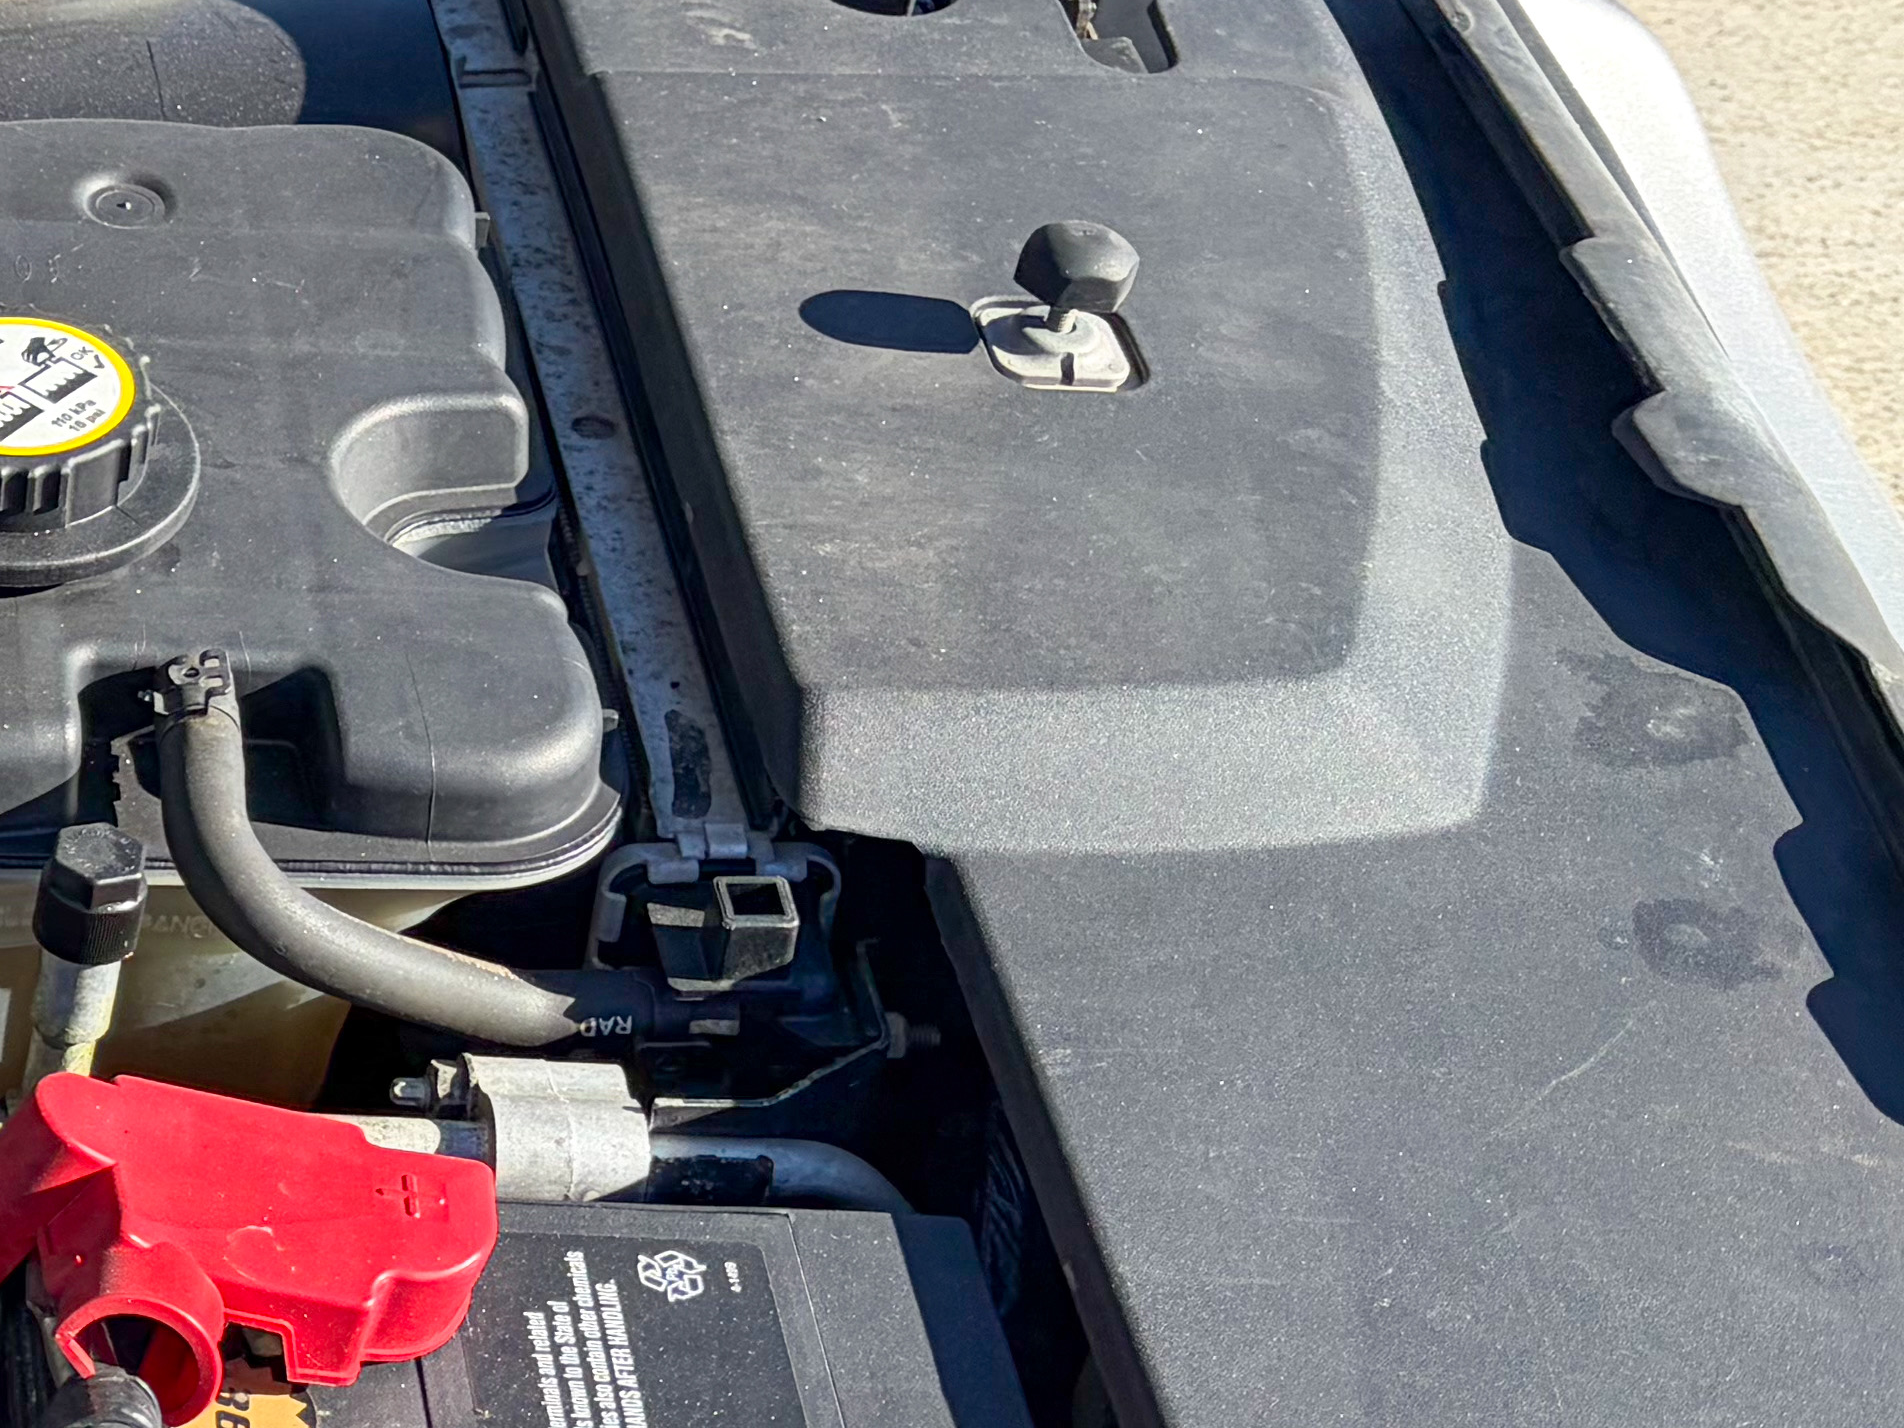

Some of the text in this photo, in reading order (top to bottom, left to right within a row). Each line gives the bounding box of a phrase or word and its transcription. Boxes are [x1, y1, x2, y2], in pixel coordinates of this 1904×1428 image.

[70, 346, 94, 361] OK
[69, 399, 97, 416] kPa
[580, 1015, 632, 1037] RAD
[563, 1250, 594, 1307] chemicals
[546, 1300, 569, 1312] of
[595, 1278, 629, 1345] HANDLING.
[523, 1311, 551, 1351] related
[552, 1313, 576, 1344] State
[577, 1308, 601, 1338] other
[531, 1352, 556, 1375] and
[558, 1345, 580, 1364] the
[583, 1339, 610, 1382] contain
[610, 1347, 638, 1387] AFTER
[562, 1366, 583, 1378] to
[567, 1379, 591, 1418] known
[593, 1383, 616, 1409] also
